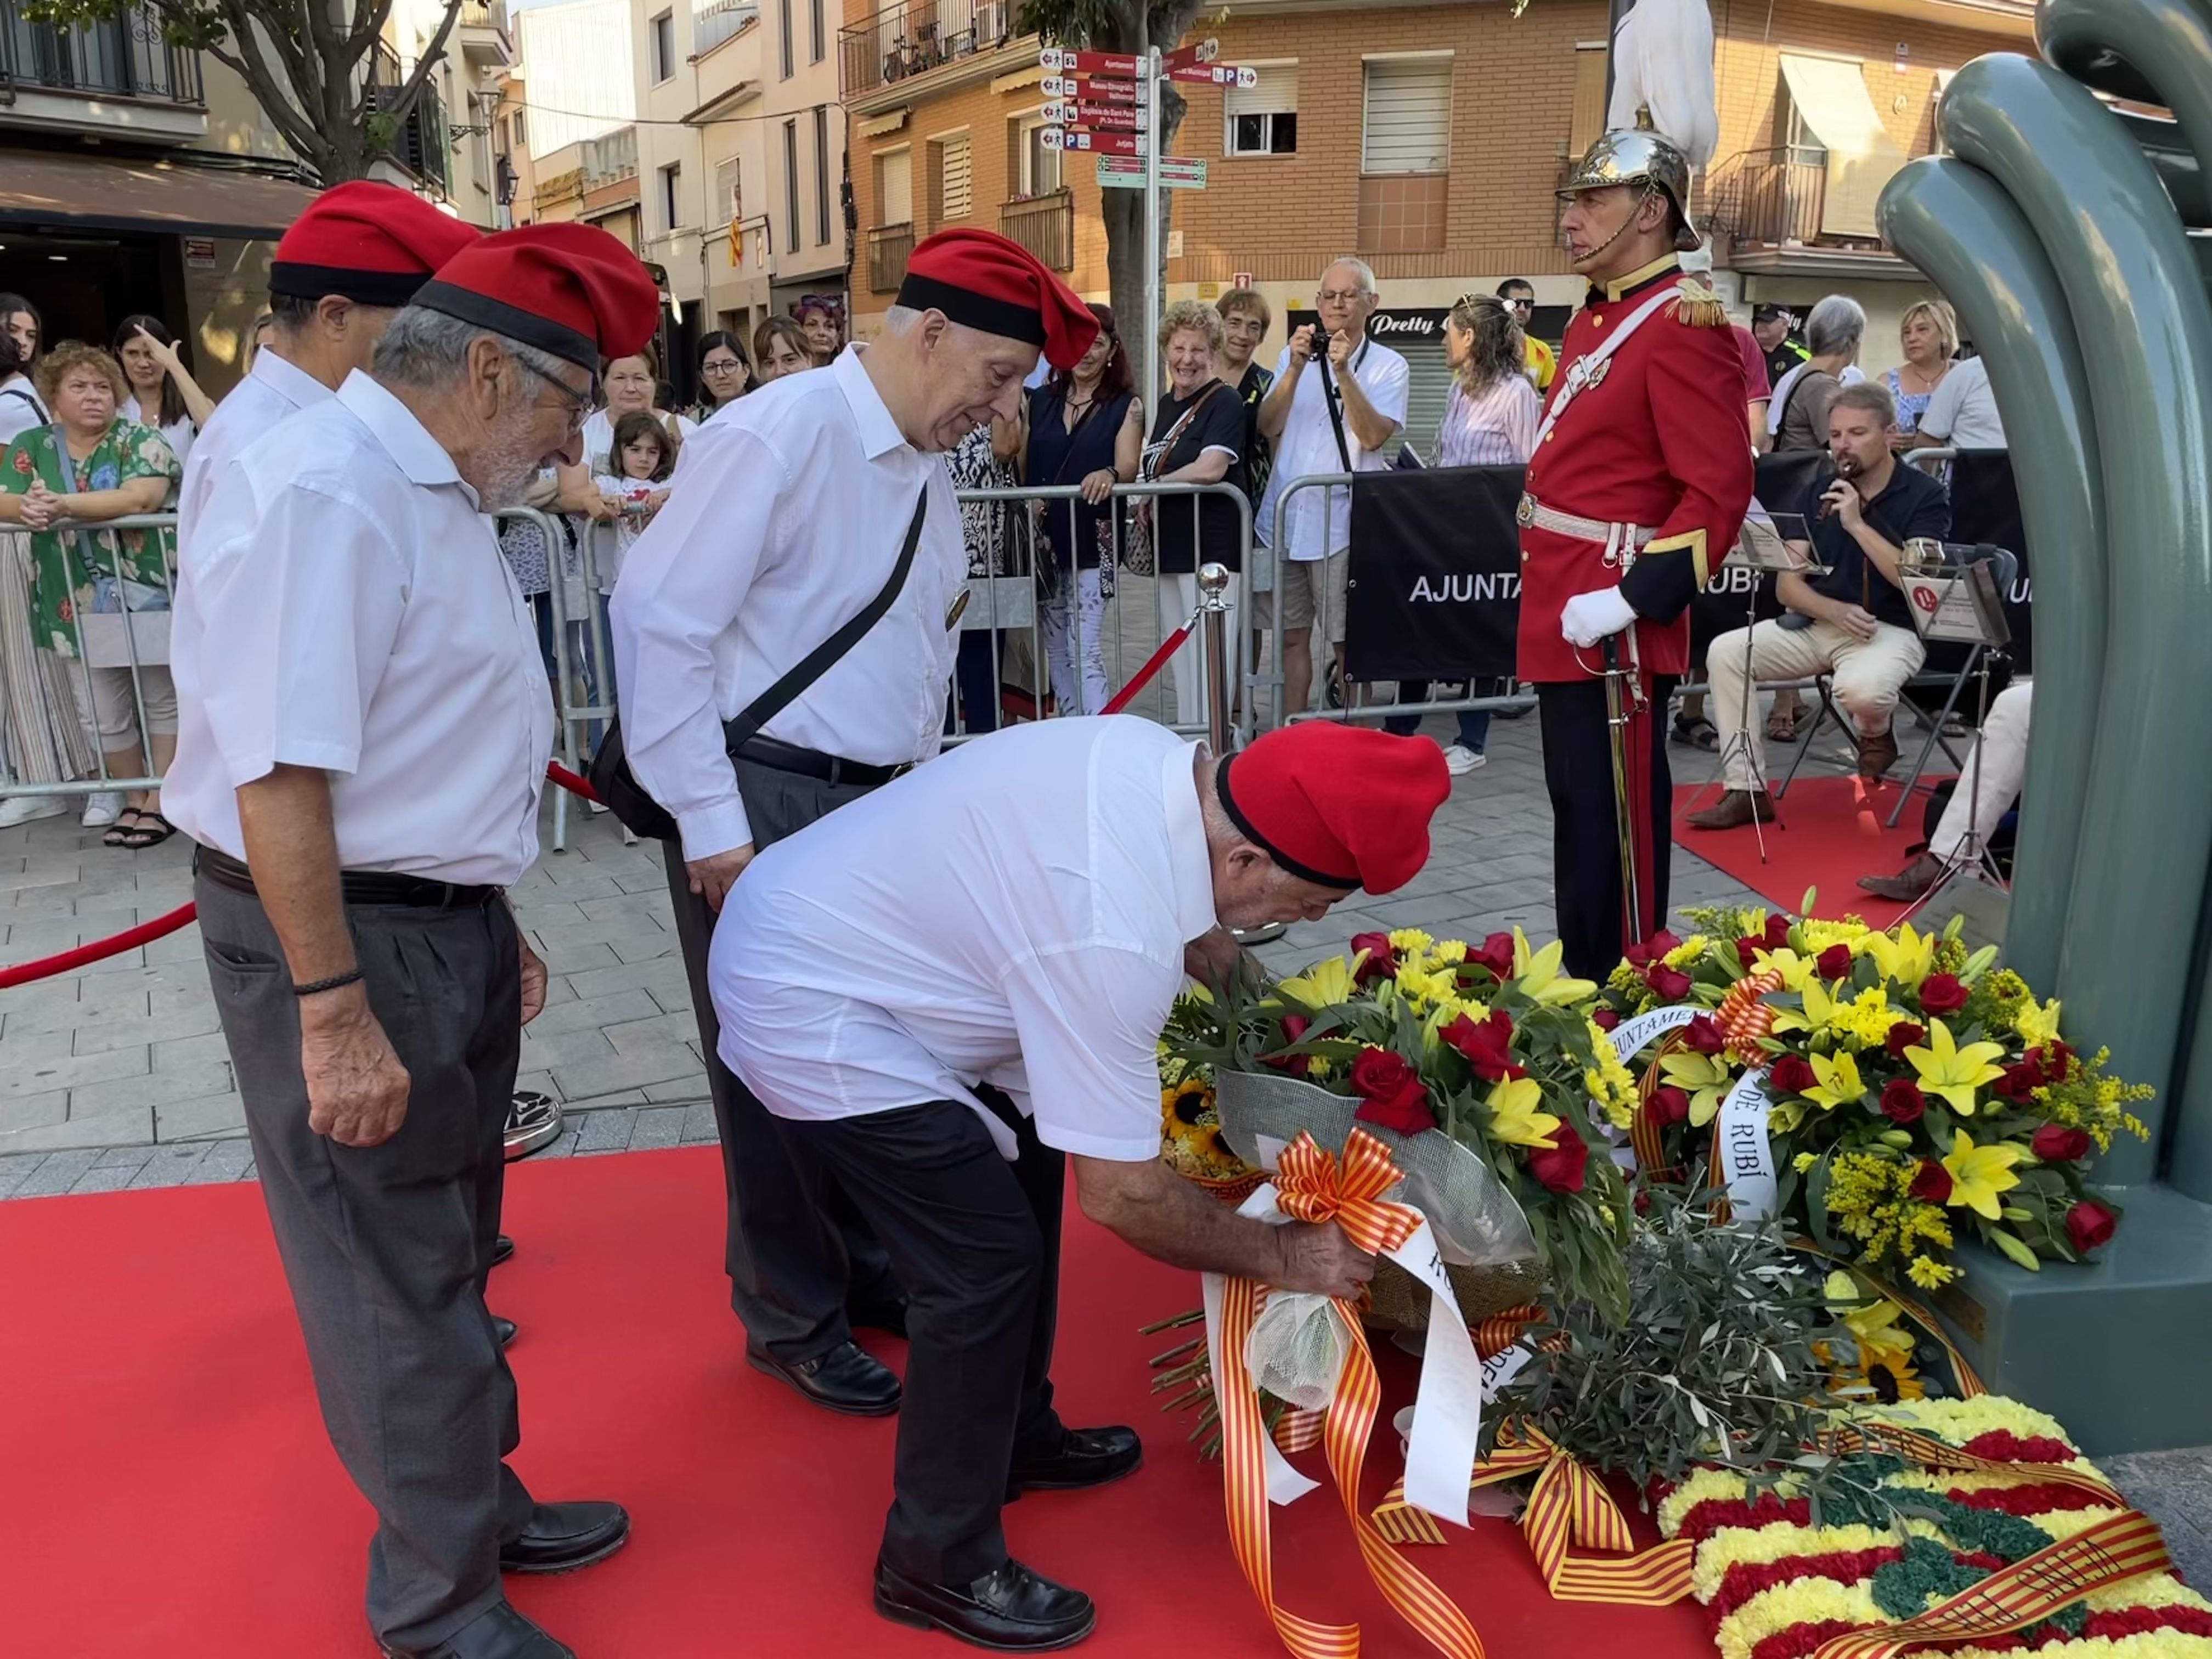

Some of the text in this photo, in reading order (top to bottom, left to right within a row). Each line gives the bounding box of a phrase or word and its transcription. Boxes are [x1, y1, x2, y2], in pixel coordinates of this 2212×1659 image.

[1371, 314, 1436, 335] Pretty
[1735, 1089, 1763, 1111] DE
[1730, 1124, 1770, 1180] RUBÍ
